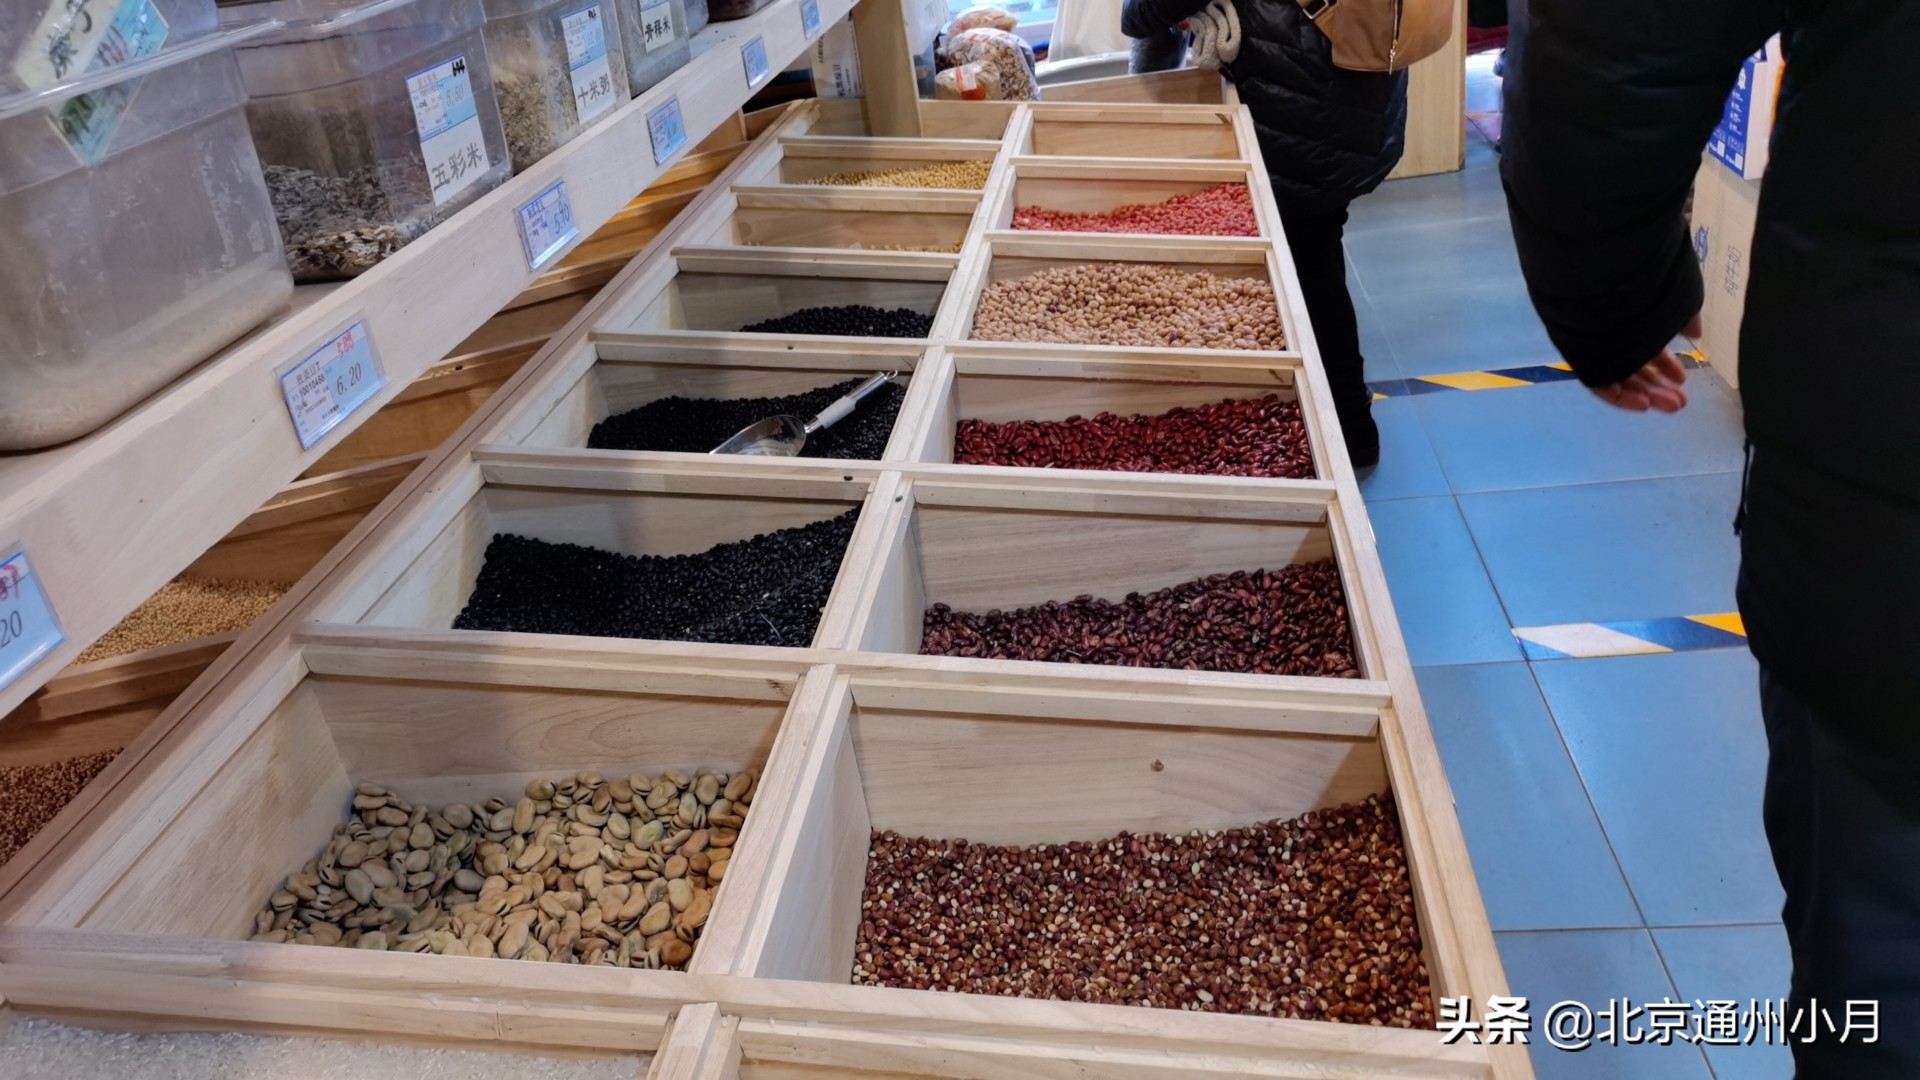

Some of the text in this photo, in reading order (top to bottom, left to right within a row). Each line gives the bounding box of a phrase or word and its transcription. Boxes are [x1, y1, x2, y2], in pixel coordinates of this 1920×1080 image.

[577, 73, 610, 108] 十米粥
[432, 142, 482, 192] 五彩米
[336, 362, 362, 396] 6.20
